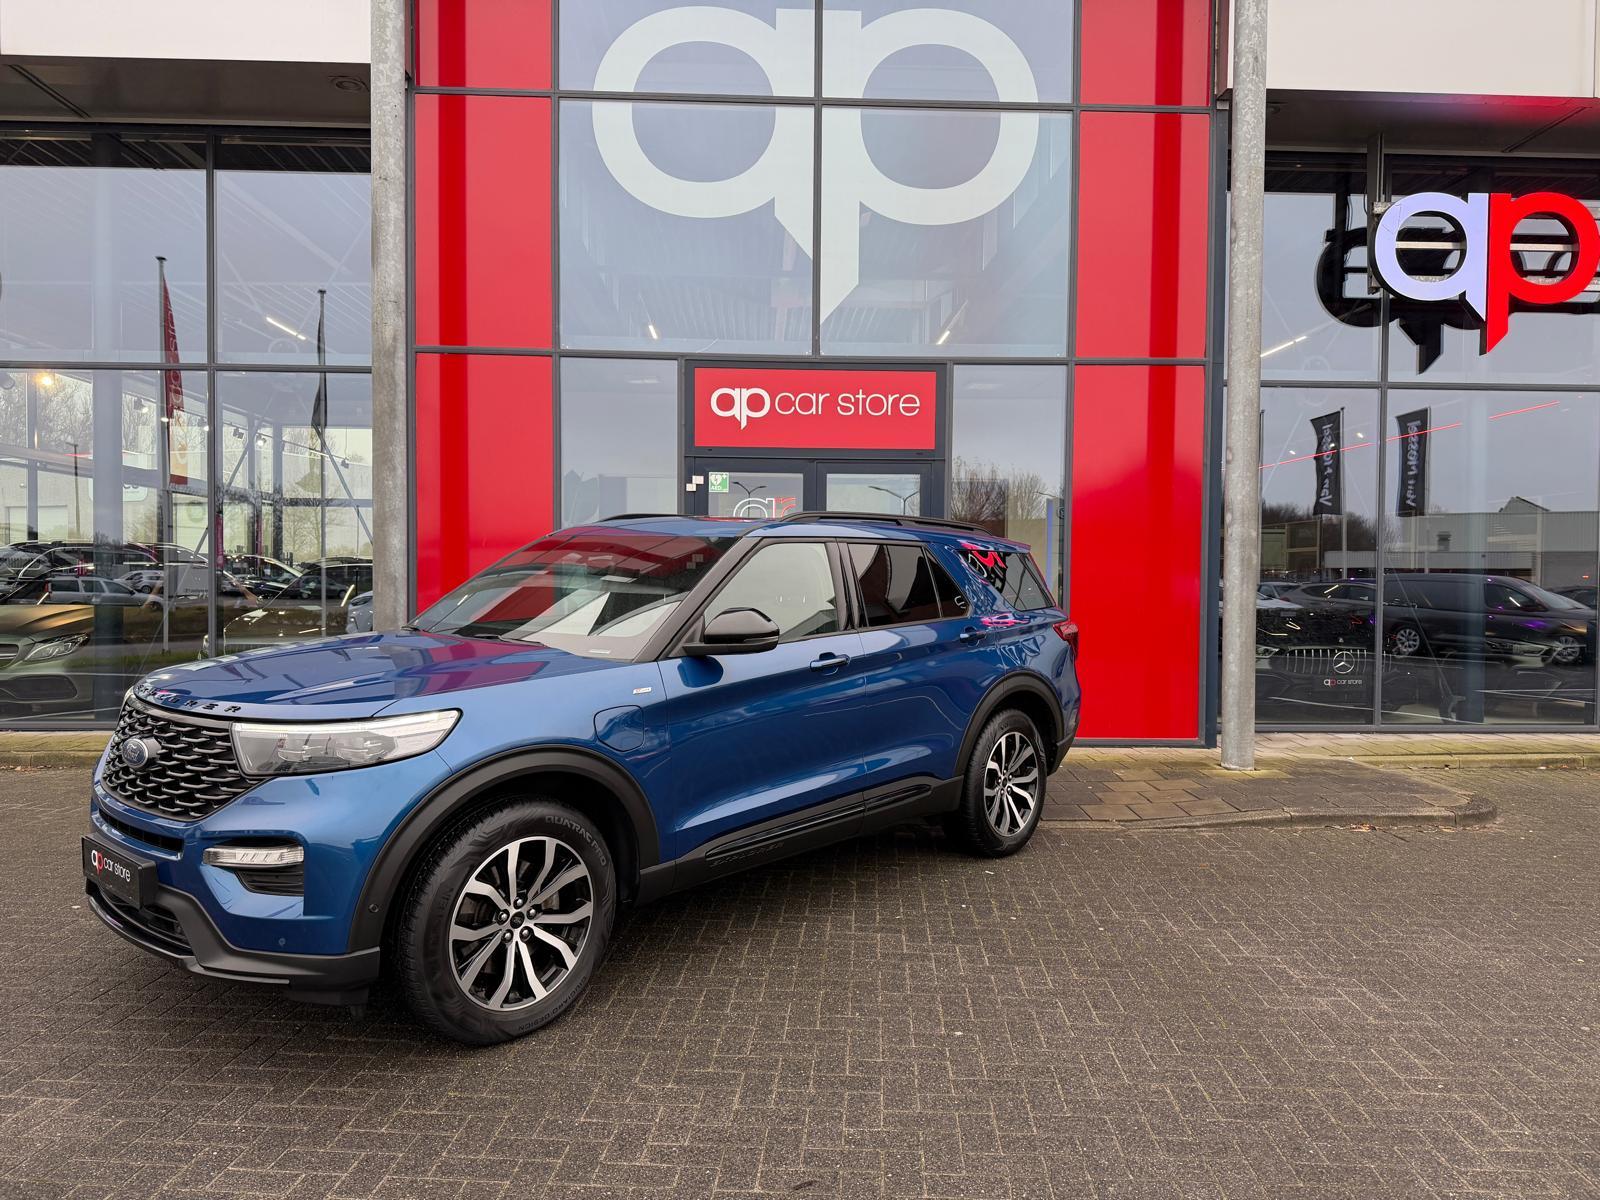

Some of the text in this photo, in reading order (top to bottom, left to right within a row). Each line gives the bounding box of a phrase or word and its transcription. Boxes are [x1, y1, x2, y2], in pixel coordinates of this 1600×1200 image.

[1374, 191, 1600, 354] ap
[710, 387, 921, 430] ap car store
[104, 857, 114, 872] car
[114, 862, 131, 882] store
